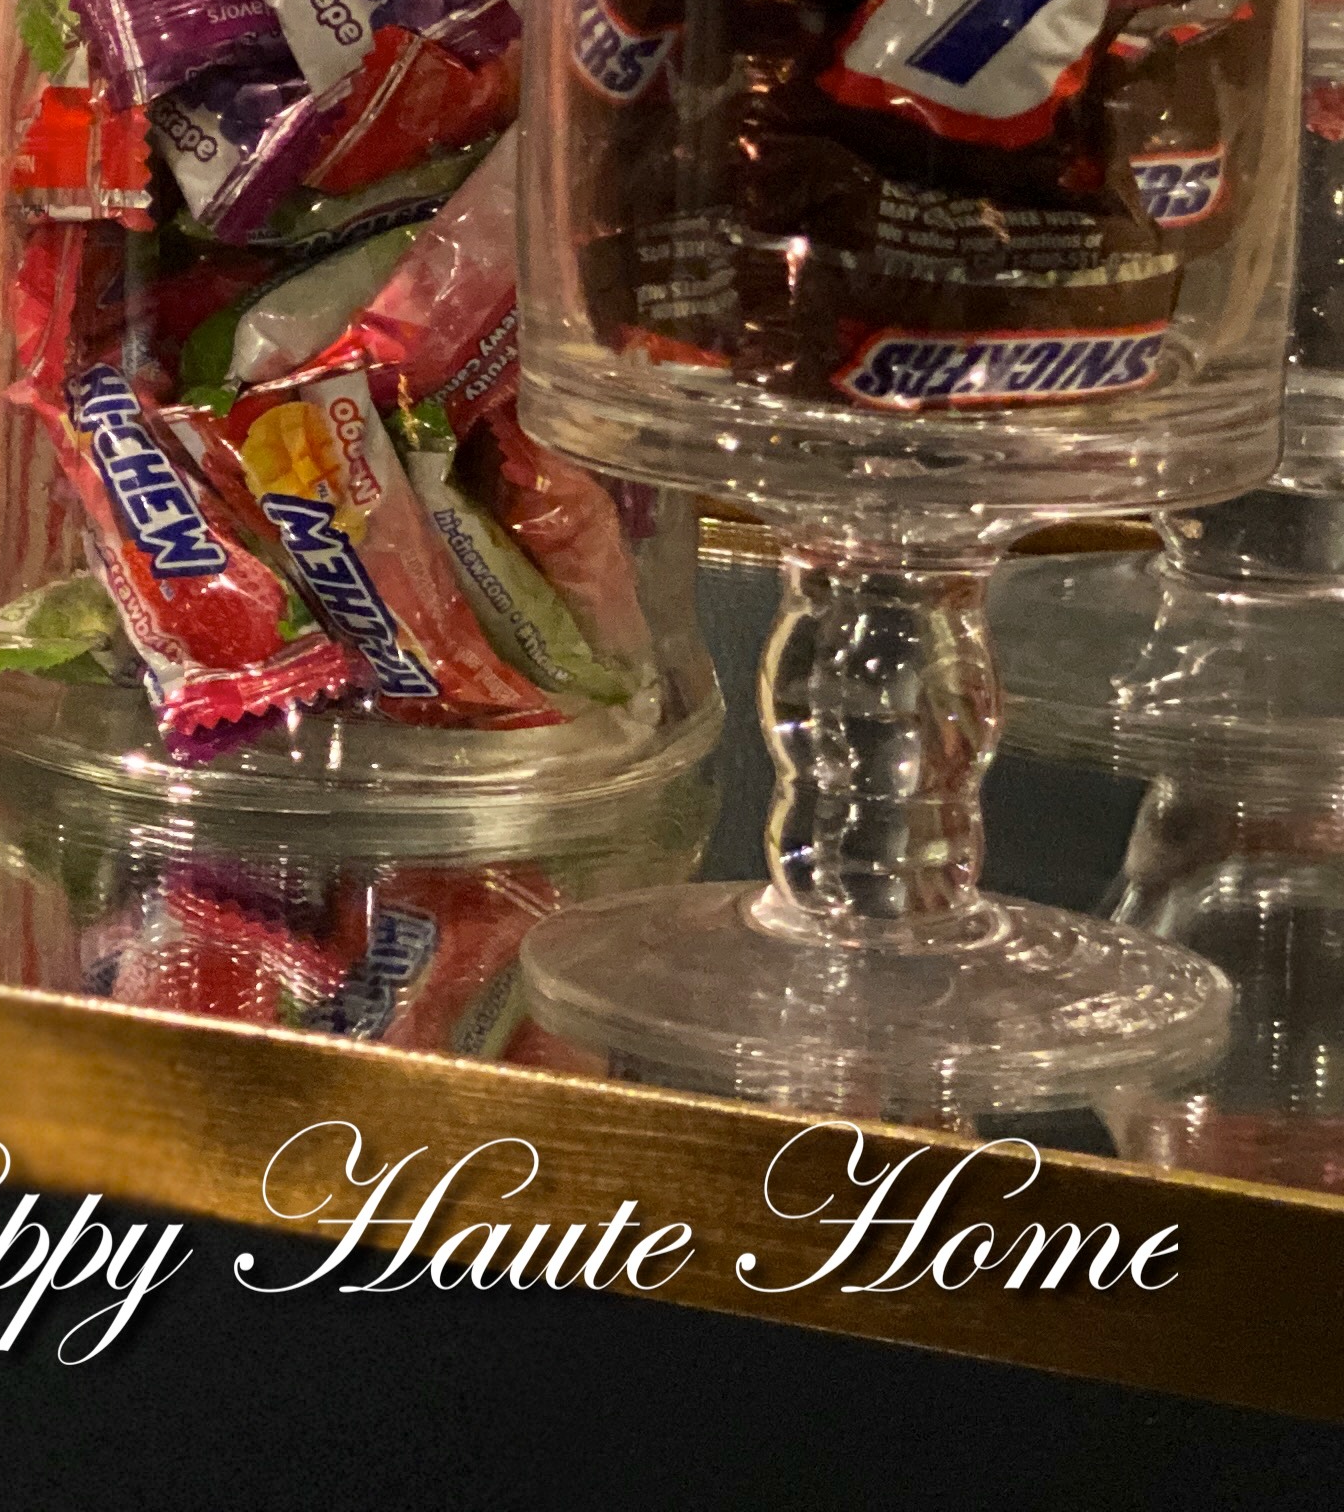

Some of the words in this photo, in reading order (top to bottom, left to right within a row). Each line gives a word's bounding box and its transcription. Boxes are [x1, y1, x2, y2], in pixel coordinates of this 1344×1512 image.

[153, 100, 216, 162] Grape
[464, 346, 518, 404] Fruity
[856, 336, 1159, 401] SNICKERS
[64, 361, 228, 579] HI-CHEW
[261, 492, 440, 698] HI-CHEW
[433, 508, 512, 614] hi-chew.com
